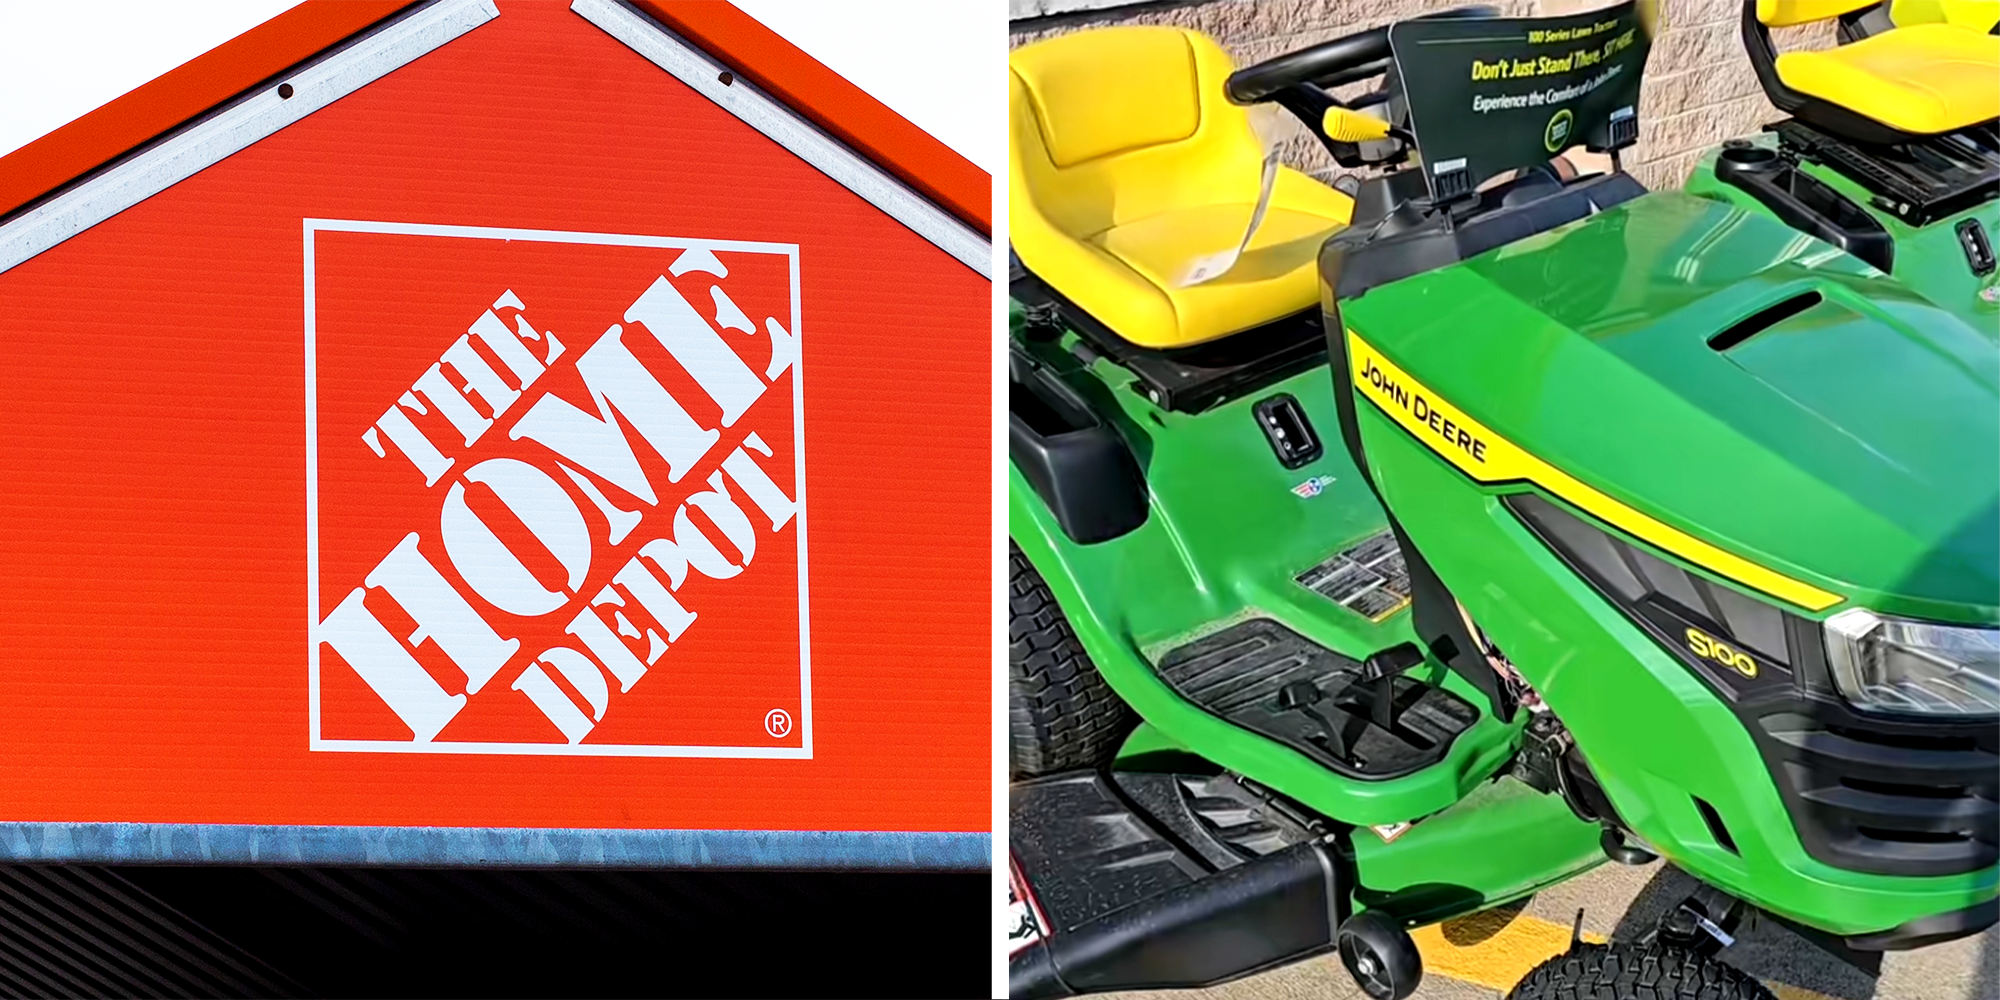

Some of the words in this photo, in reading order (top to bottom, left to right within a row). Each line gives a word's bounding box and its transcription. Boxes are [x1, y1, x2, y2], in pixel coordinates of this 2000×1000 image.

[1472, 59, 1508, 80] Don't
[1509, 58, 1537, 78] Just
[1537, 52, 1573, 75] Stand
[1528, 30, 1544, 43] 100
[1545, 29, 1571, 43] Series
[1572, 28, 1593, 39] Lawn
[1473, 94, 1527, 114] Experience
[1529, 90, 1545, 106] the
[1546, 85, 1580, 104] Comfort
[361, 288, 567, 488] THE
[1361, 356, 1409, 411] JOHN
[1413, 394, 1487, 464] DEERE
[318, 247, 795, 742] HOME
[510, 430, 797, 745] DEPOT
[1686, 627, 1758, 678] S100
